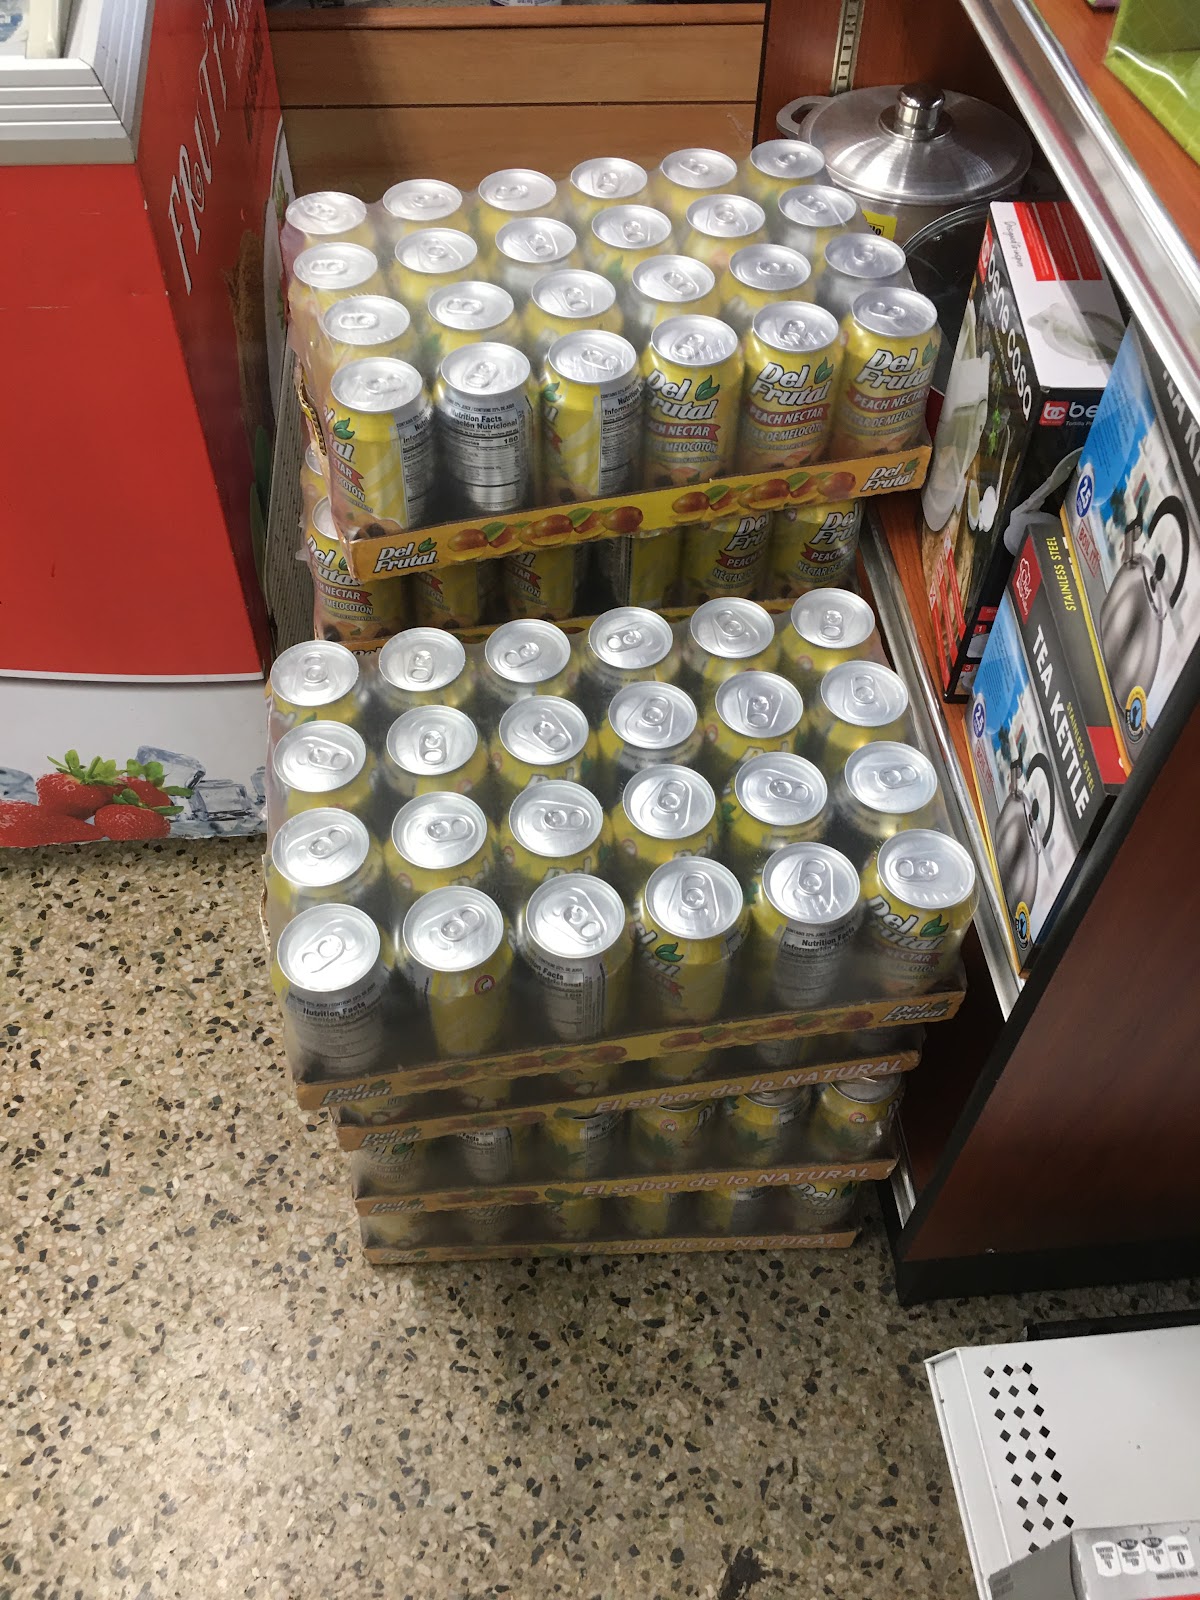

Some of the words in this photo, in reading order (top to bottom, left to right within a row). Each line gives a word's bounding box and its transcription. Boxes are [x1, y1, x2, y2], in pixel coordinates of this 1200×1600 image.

[987, 243, 1010, 334] bene
[1007, 327, 1032, 421] casa
[865, 347, 918, 373] Del
[646, 369, 692, 401] Del
[757, 361, 811, 388] Del
[750, 378, 833, 406] Frutal
[854, 393, 889, 410] PEACH
[450, 407, 480, 423] Nutrition
[481, 415, 502, 423] Facts
[749, 405, 783, 424] PEACH
[784, 407, 824, 424] NECTAR
[1068, 401, 1100, 418] be
[476, 418, 518, 430] Nutricional
[668, 425, 710, 437] NECTAR
[868, 462, 905, 479] Del
[860, 470, 916, 493] Frutal
[307, 534, 336, 568] Del
[378, 542, 415, 561] Del
[1046, 536, 1061, 560] STEEL
[373, 550, 438, 574] Frutal
[325, 586, 361, 601] NECTAR
[1053, 564, 1077, 611] STAINLESS
[1033, 624, 1053, 698] TEA
[1050, 690, 1090, 820] KETTLE
[1067, 701, 1085, 758] STAINLESS
[1083, 760, 1095, 794] STEEL
[868, 894, 919, 934] Del
[801, 937, 836, 947] Nutrition
[837, 926, 855, 941] Facts
[543, 967, 564, 981] Facts
[303, 1007, 340, 1017] Nutrition
[343, 1001, 366, 1015] Facts
[879, 1008, 948, 1023] Frutal
[891, 1002, 932, 1015] Del
[326, 1084, 367, 1098] Del
[628, 1090, 698, 1109] sabor
[709, 1083, 743, 1097] de
[749, 1079, 773, 1092] lo
[782, 1060, 902, 1087] NATURAL
[582, 1184, 605, 1196] El
[612, 1179, 683, 1194] sabor
[688, 1176, 720, 1187] de
[726, 1175, 749, 1186] lo
[757, 1167, 870, 1183] NATURAL
[734, 1235, 839, 1248] NATURAL
